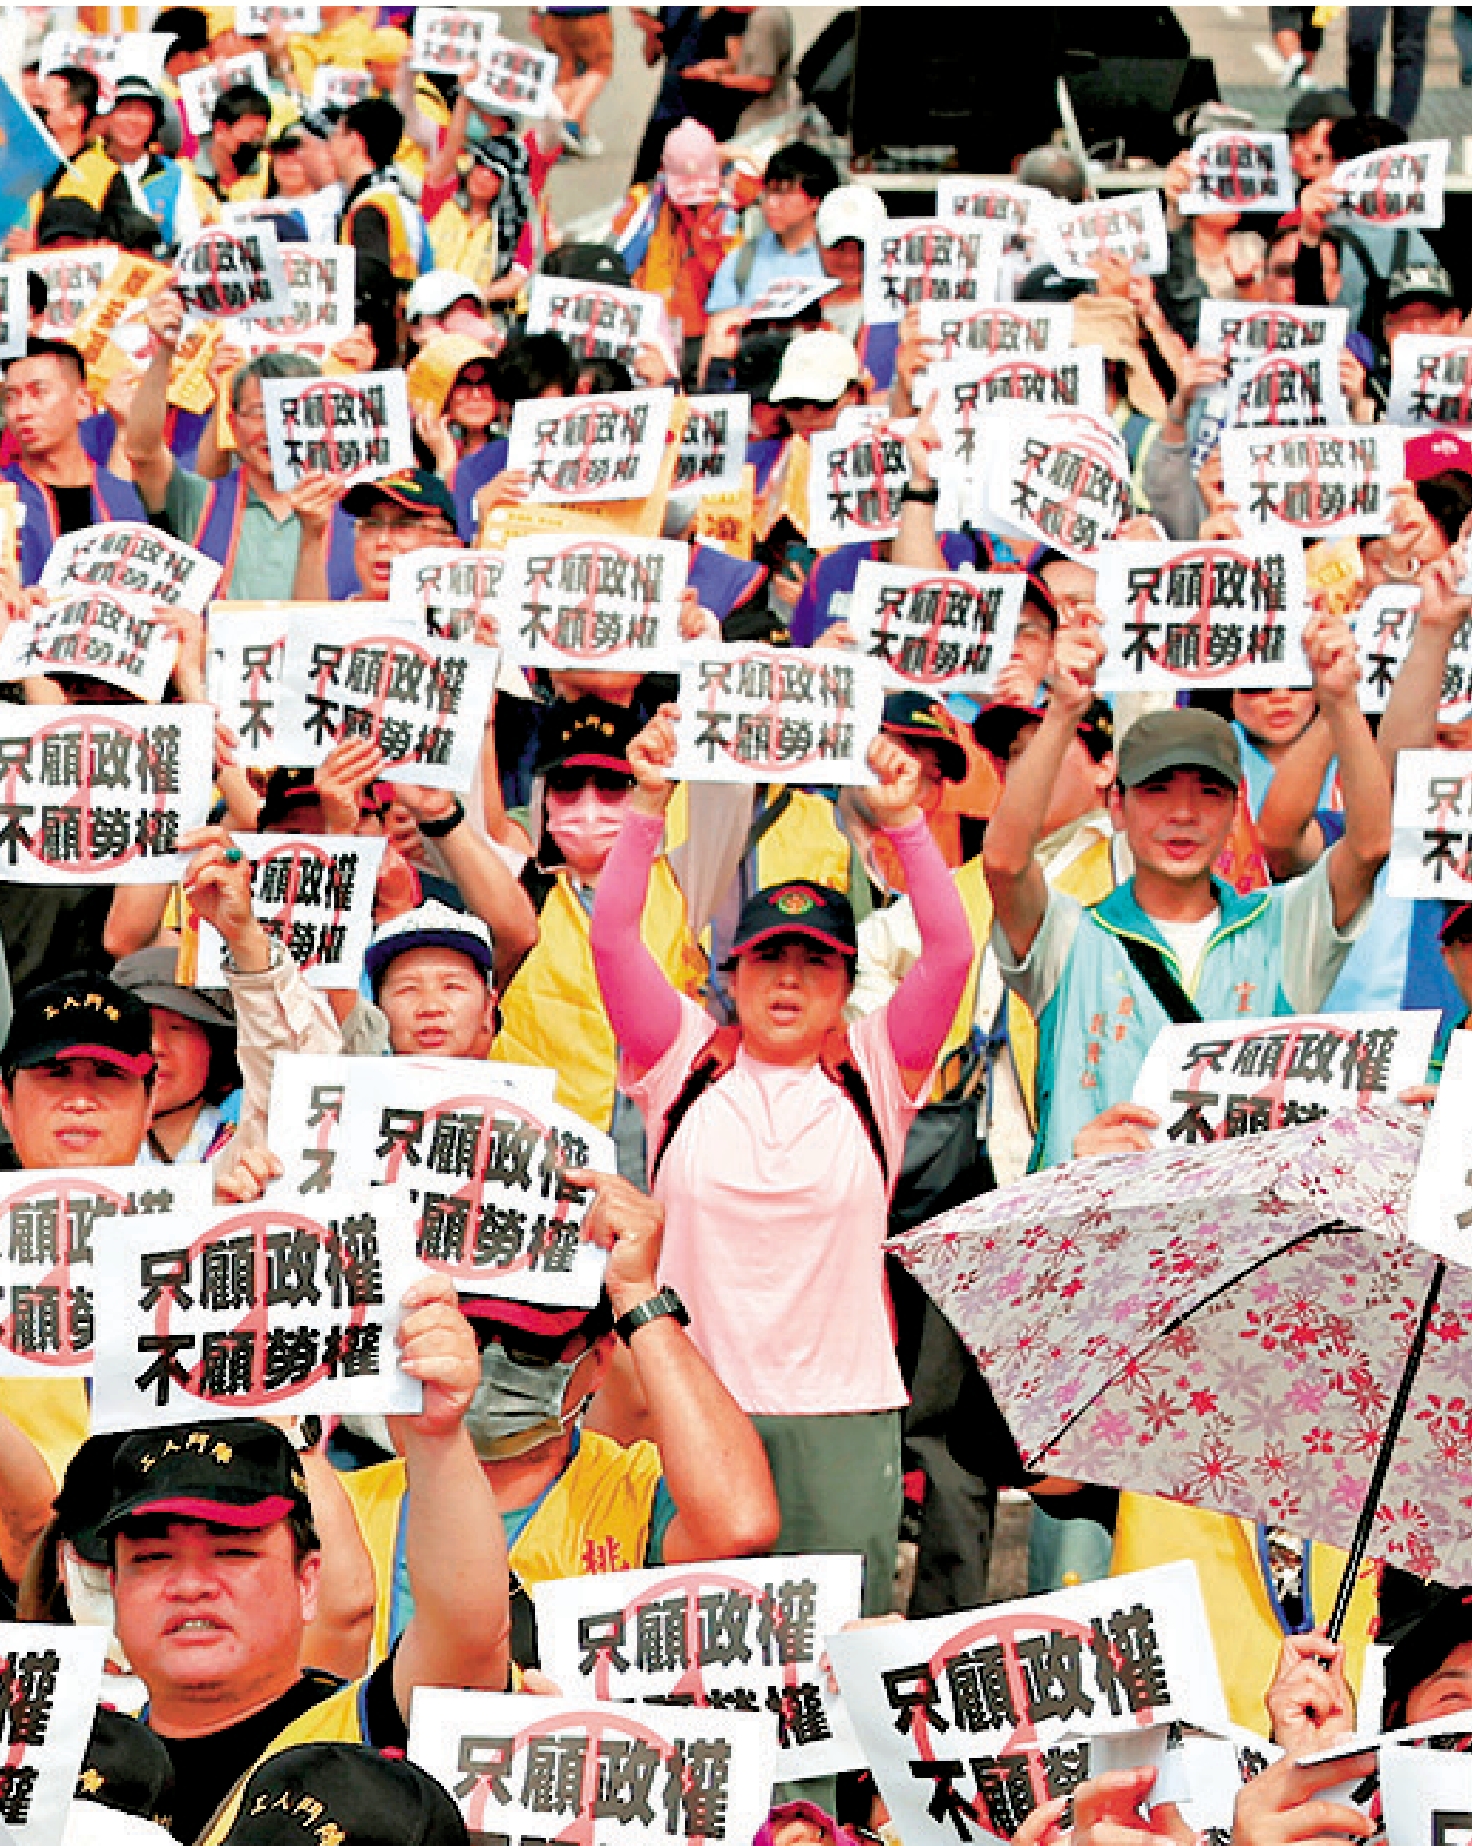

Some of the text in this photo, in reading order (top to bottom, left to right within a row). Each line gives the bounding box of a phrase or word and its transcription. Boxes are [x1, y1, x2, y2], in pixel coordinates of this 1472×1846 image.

[281, 388, 387, 431] 只顧政權
[535, 405, 650, 447] 只顧政權
[283, 431, 391, 472] 不顧勞權
[527, 453, 641, 494] 不顧勞權
[1247, 438, 1378, 469] 只顧政權
[1248, 480, 1380, 524] 不顧勞權
[527, 552, 664, 601] 只顧政權
[1125, 559, 1287, 612] 只顧政權
[520, 601, 660, 652] 不顧勞權
[876, 585, 1001, 633] 只顧政權
[868, 628, 993, 679] 不顧勞權
[1121, 621, 1286, 673] 不顧勞權
[308, 643, 467, 713] 只顧政權
[698, 661, 856, 709] 只顧政權
[694, 711, 854, 766] 不顧勞權
[1181, 1028, 1399, 1091] 只顧政權
[376, 1106, 592, 1204] 只顧政權
[137, 1215, 385, 1313] 只顧政權
[135, 1323, 384, 1407] 不顧勞權
[575, 1582, 817, 1675] 只顧政權
[882, 1605, 1171, 1734] 只顧政權
[454, 1735, 734, 1842] 只顧政權
